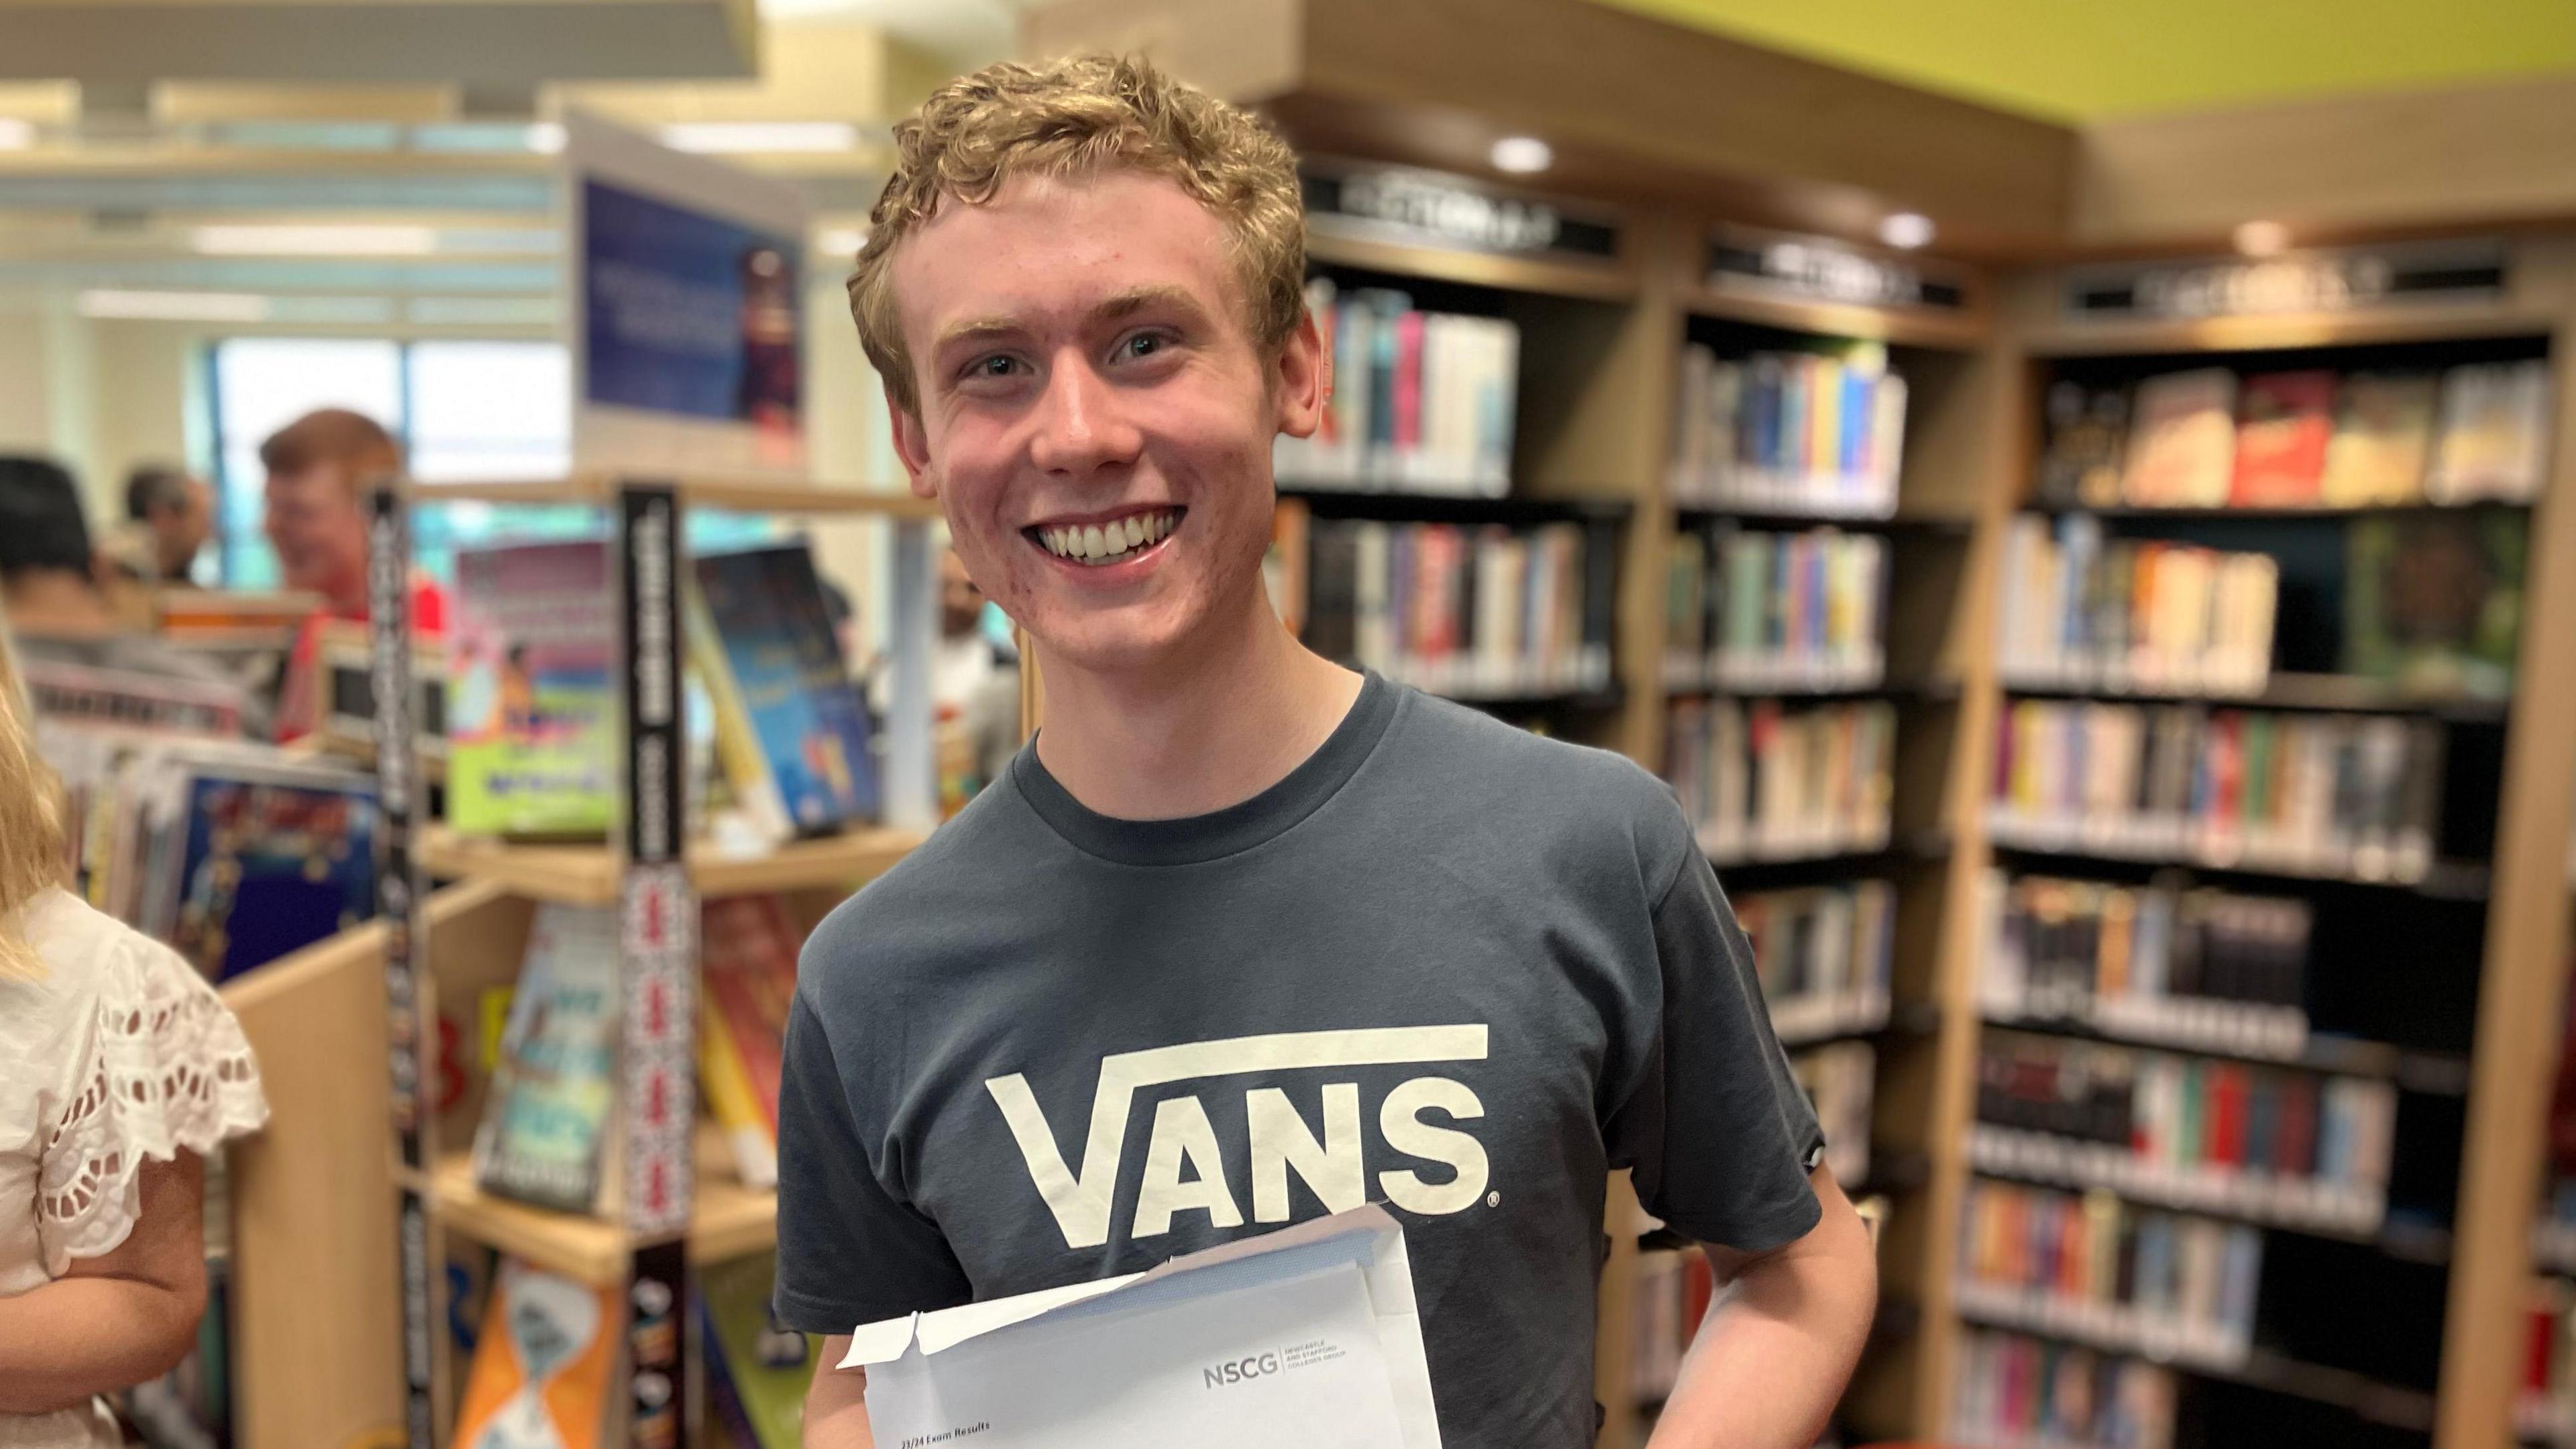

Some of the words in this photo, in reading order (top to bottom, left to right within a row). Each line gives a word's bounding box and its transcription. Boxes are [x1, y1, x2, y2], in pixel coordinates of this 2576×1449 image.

[986, 1024, 1488, 1248] VANS
[1285, 1340, 1326, 1354] NEWCASTLE
[1287, 1354, 1301, 1362] AND
[1302, 1345, 1338, 1358] STAFFORD
[1203, 1353, 1278, 1389] NSCG
[1288, 1356, 1322, 1369] COLLEGES
[1323, 1350, 1347, 1360] GROUP
[902, 1436, 924, 1449] 23/24
[926, 1432, 952, 1446] Exam
[955, 1421, 990, 1437] Results
